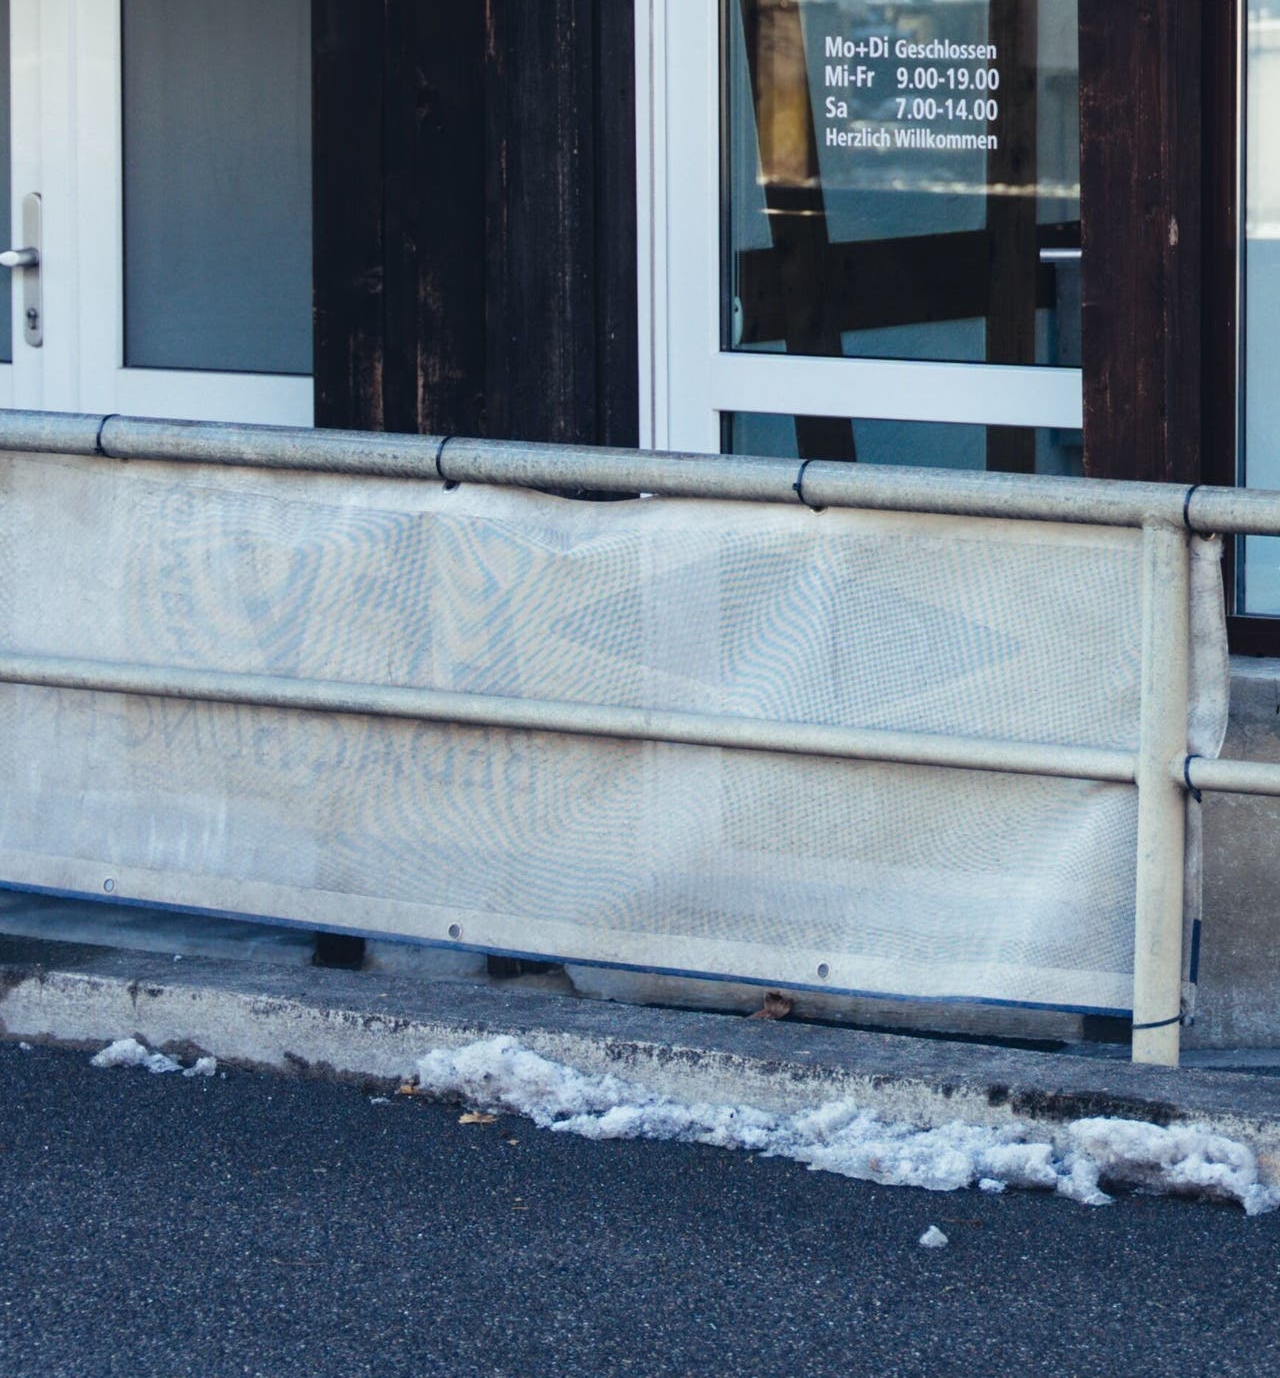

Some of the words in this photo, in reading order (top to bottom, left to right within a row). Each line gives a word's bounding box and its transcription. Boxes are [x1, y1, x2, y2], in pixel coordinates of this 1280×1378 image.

[825, 36, 889, 58] Mo+Di
[895, 39, 997, 59] Geschlossen
[825, 65, 875, 87] Mi-Fr
[896, 67, 1000, 90] 9.00-19.00
[825, 96, 848, 118] Sa
[895, 97, 998, 121] 7.00-14.00
[825, 128, 890, 147] Herzlich
[894, 128, 998, 149] Willkommen
